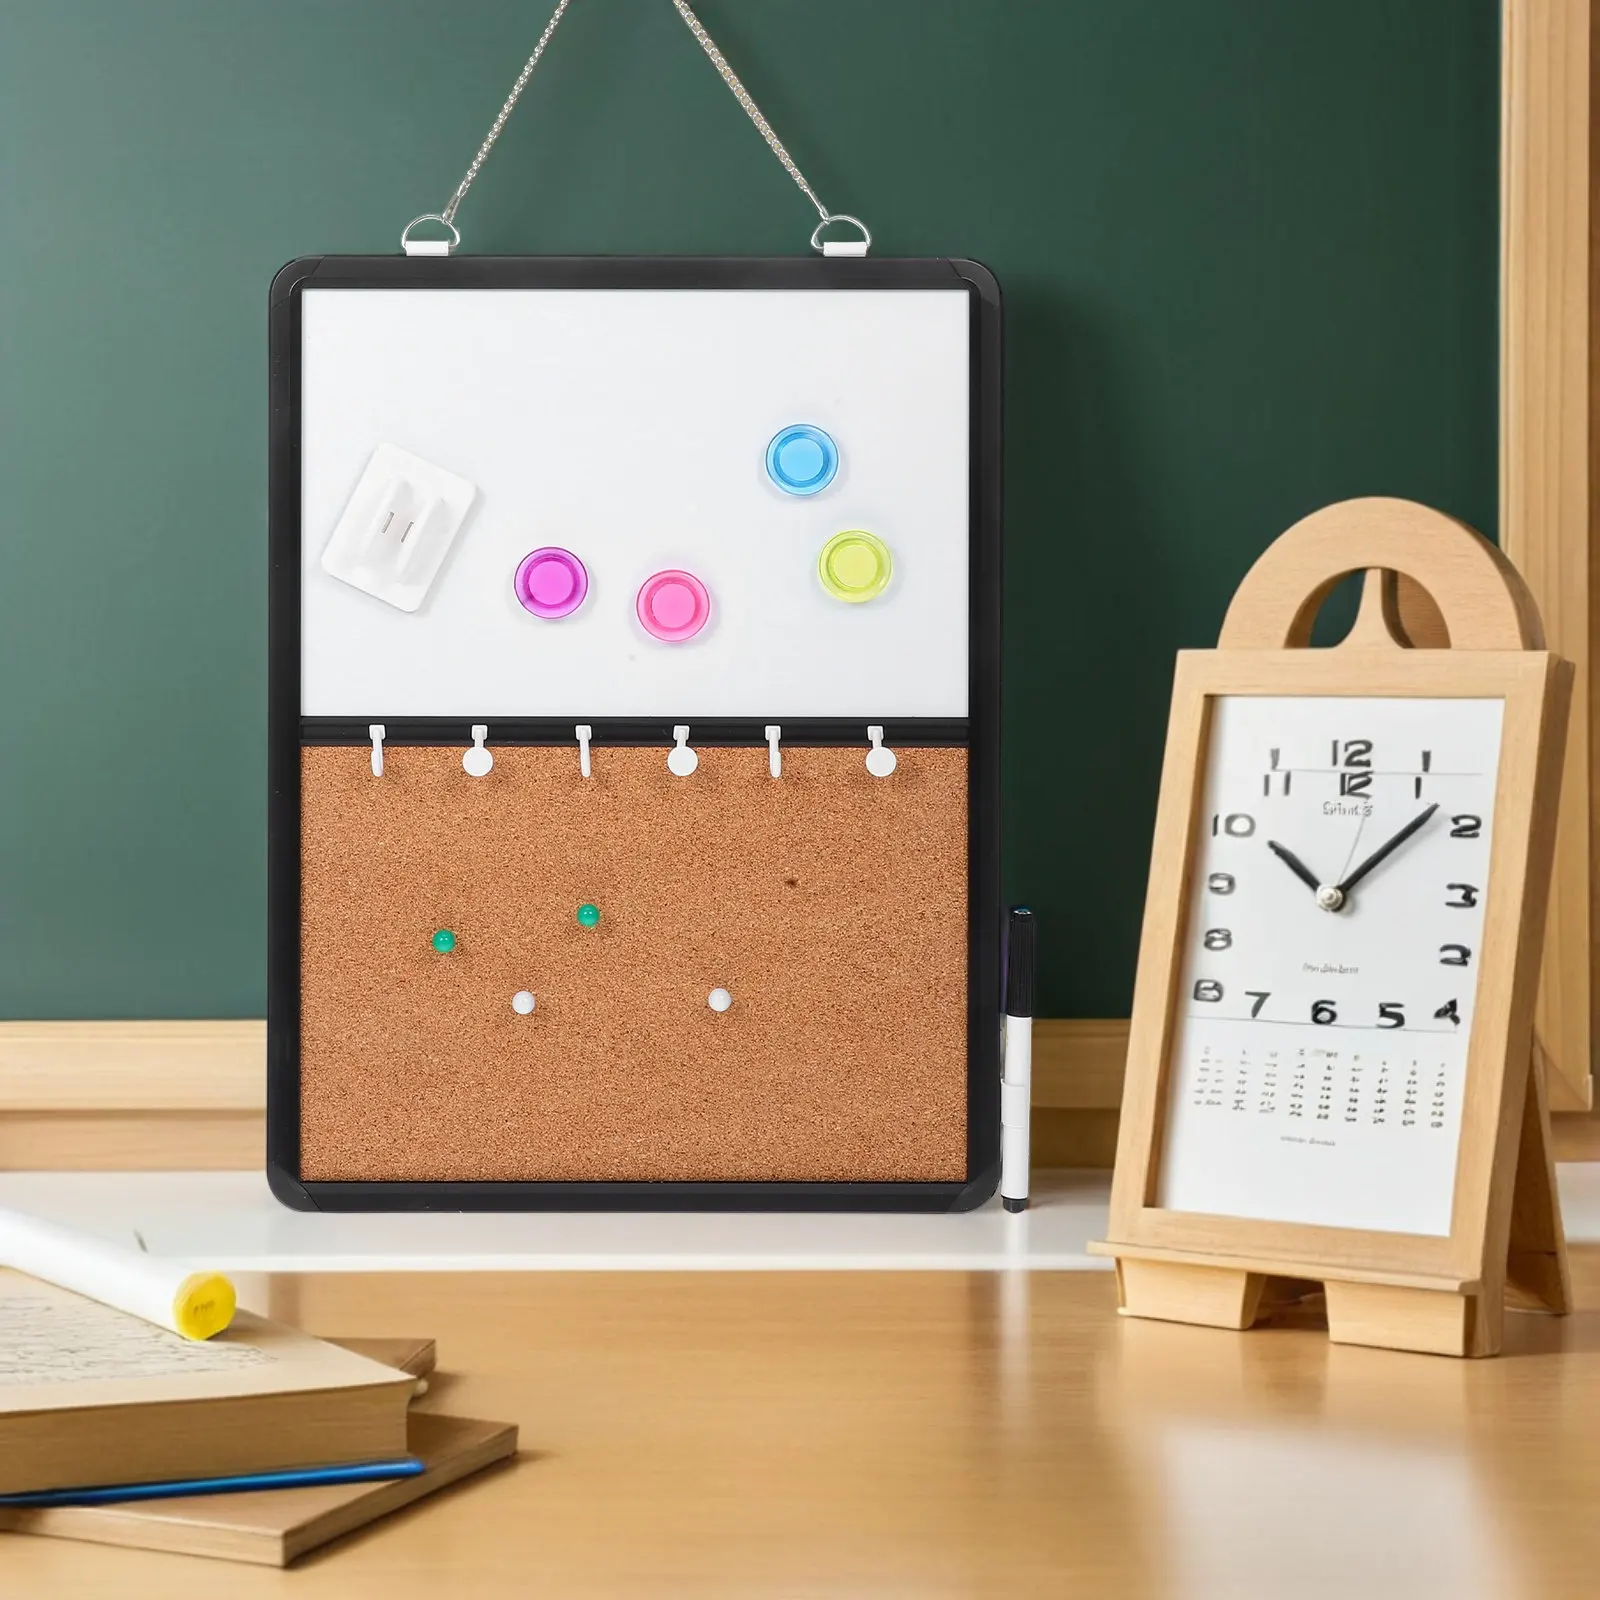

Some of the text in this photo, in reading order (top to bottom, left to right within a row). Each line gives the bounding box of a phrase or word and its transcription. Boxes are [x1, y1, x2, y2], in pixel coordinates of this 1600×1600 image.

[1331, 739, 1373, 768] 12
[1212, 813, 1256, 838] 10
[1450, 814, 1482, 838] 2
[1203, 928, 1233, 951] 8
[1245, 991, 1271, 1019] 7
[1311, 1000, 1337, 1025] 6
[1376, 1002, 1405, 1029] 5
